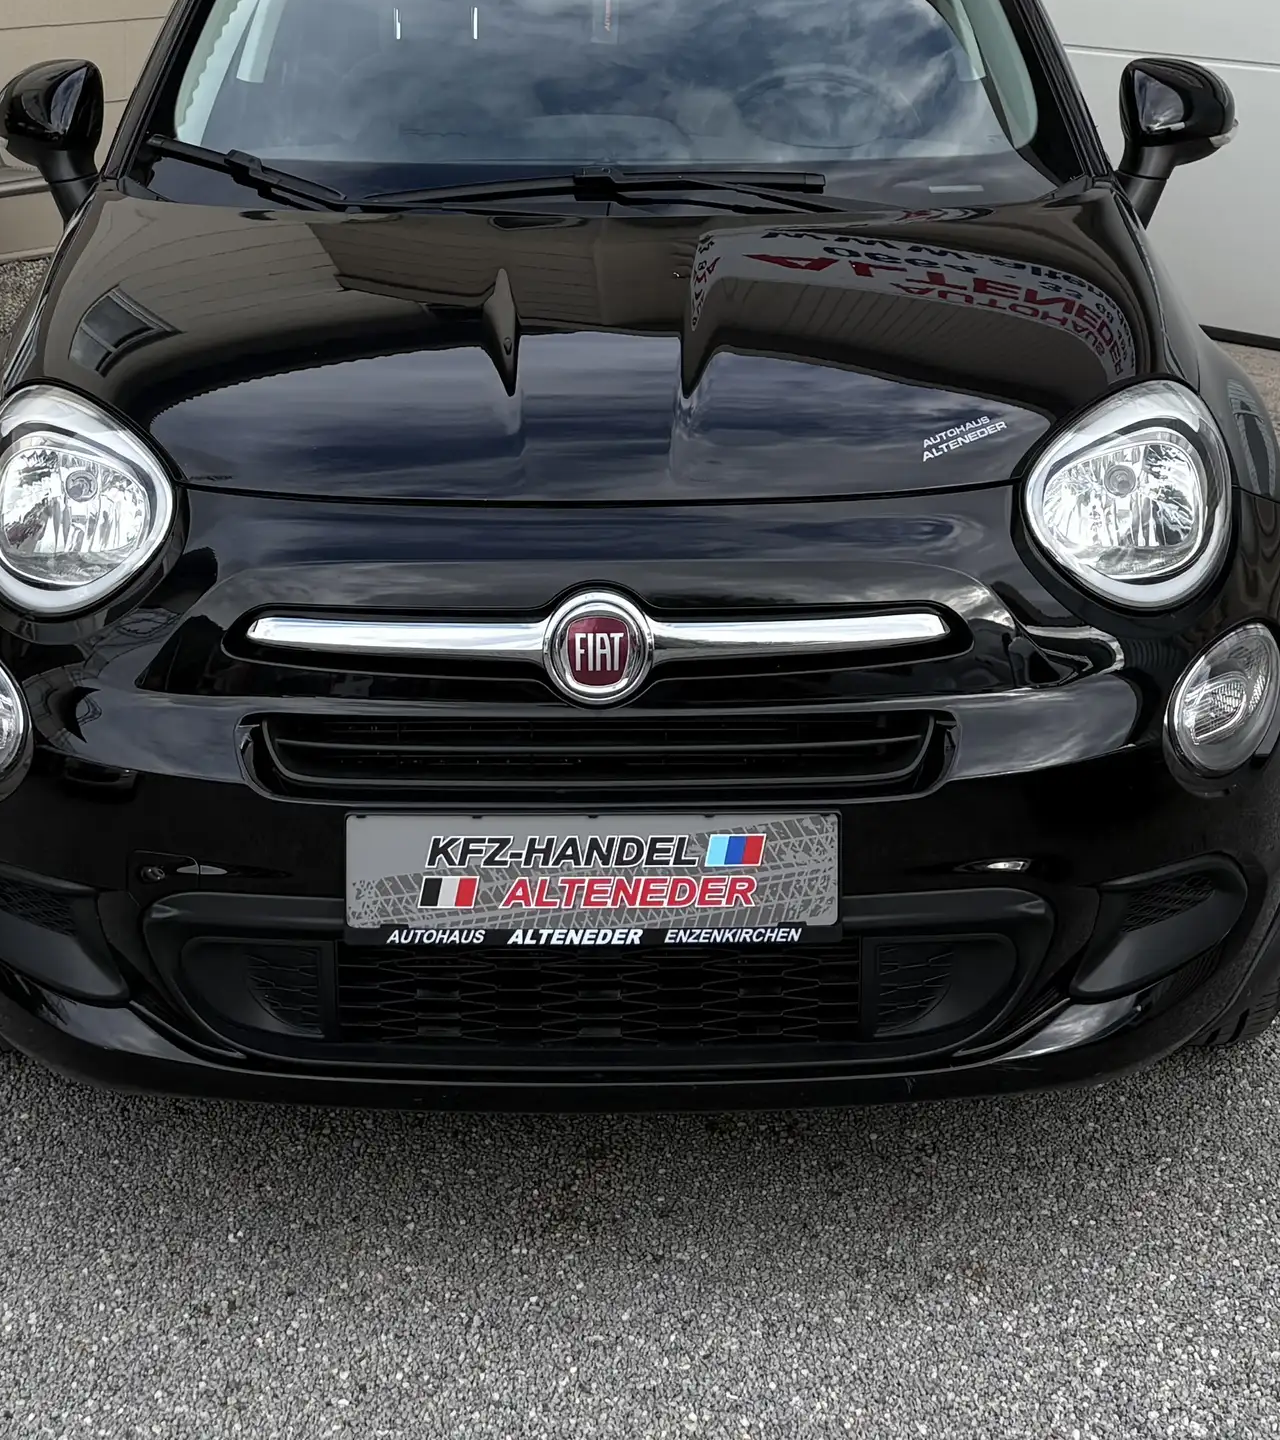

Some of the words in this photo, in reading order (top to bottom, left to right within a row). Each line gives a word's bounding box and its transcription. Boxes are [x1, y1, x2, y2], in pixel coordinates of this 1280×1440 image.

[922, 420, 1008, 463] ALTENEDER
[923, 415, 991, 449] AUTOHAUS
[574, 632, 625, 672] FIAT
[424, 835, 700, 869] KFZ-HANDEL
[498, 875, 758, 909] ALTENEDER
[385, 928, 486, 945] AUTOHAUS
[506, 928, 644, 946] ALTENEDER
[664, 927, 803, 944] ENZENKIRCHEN
